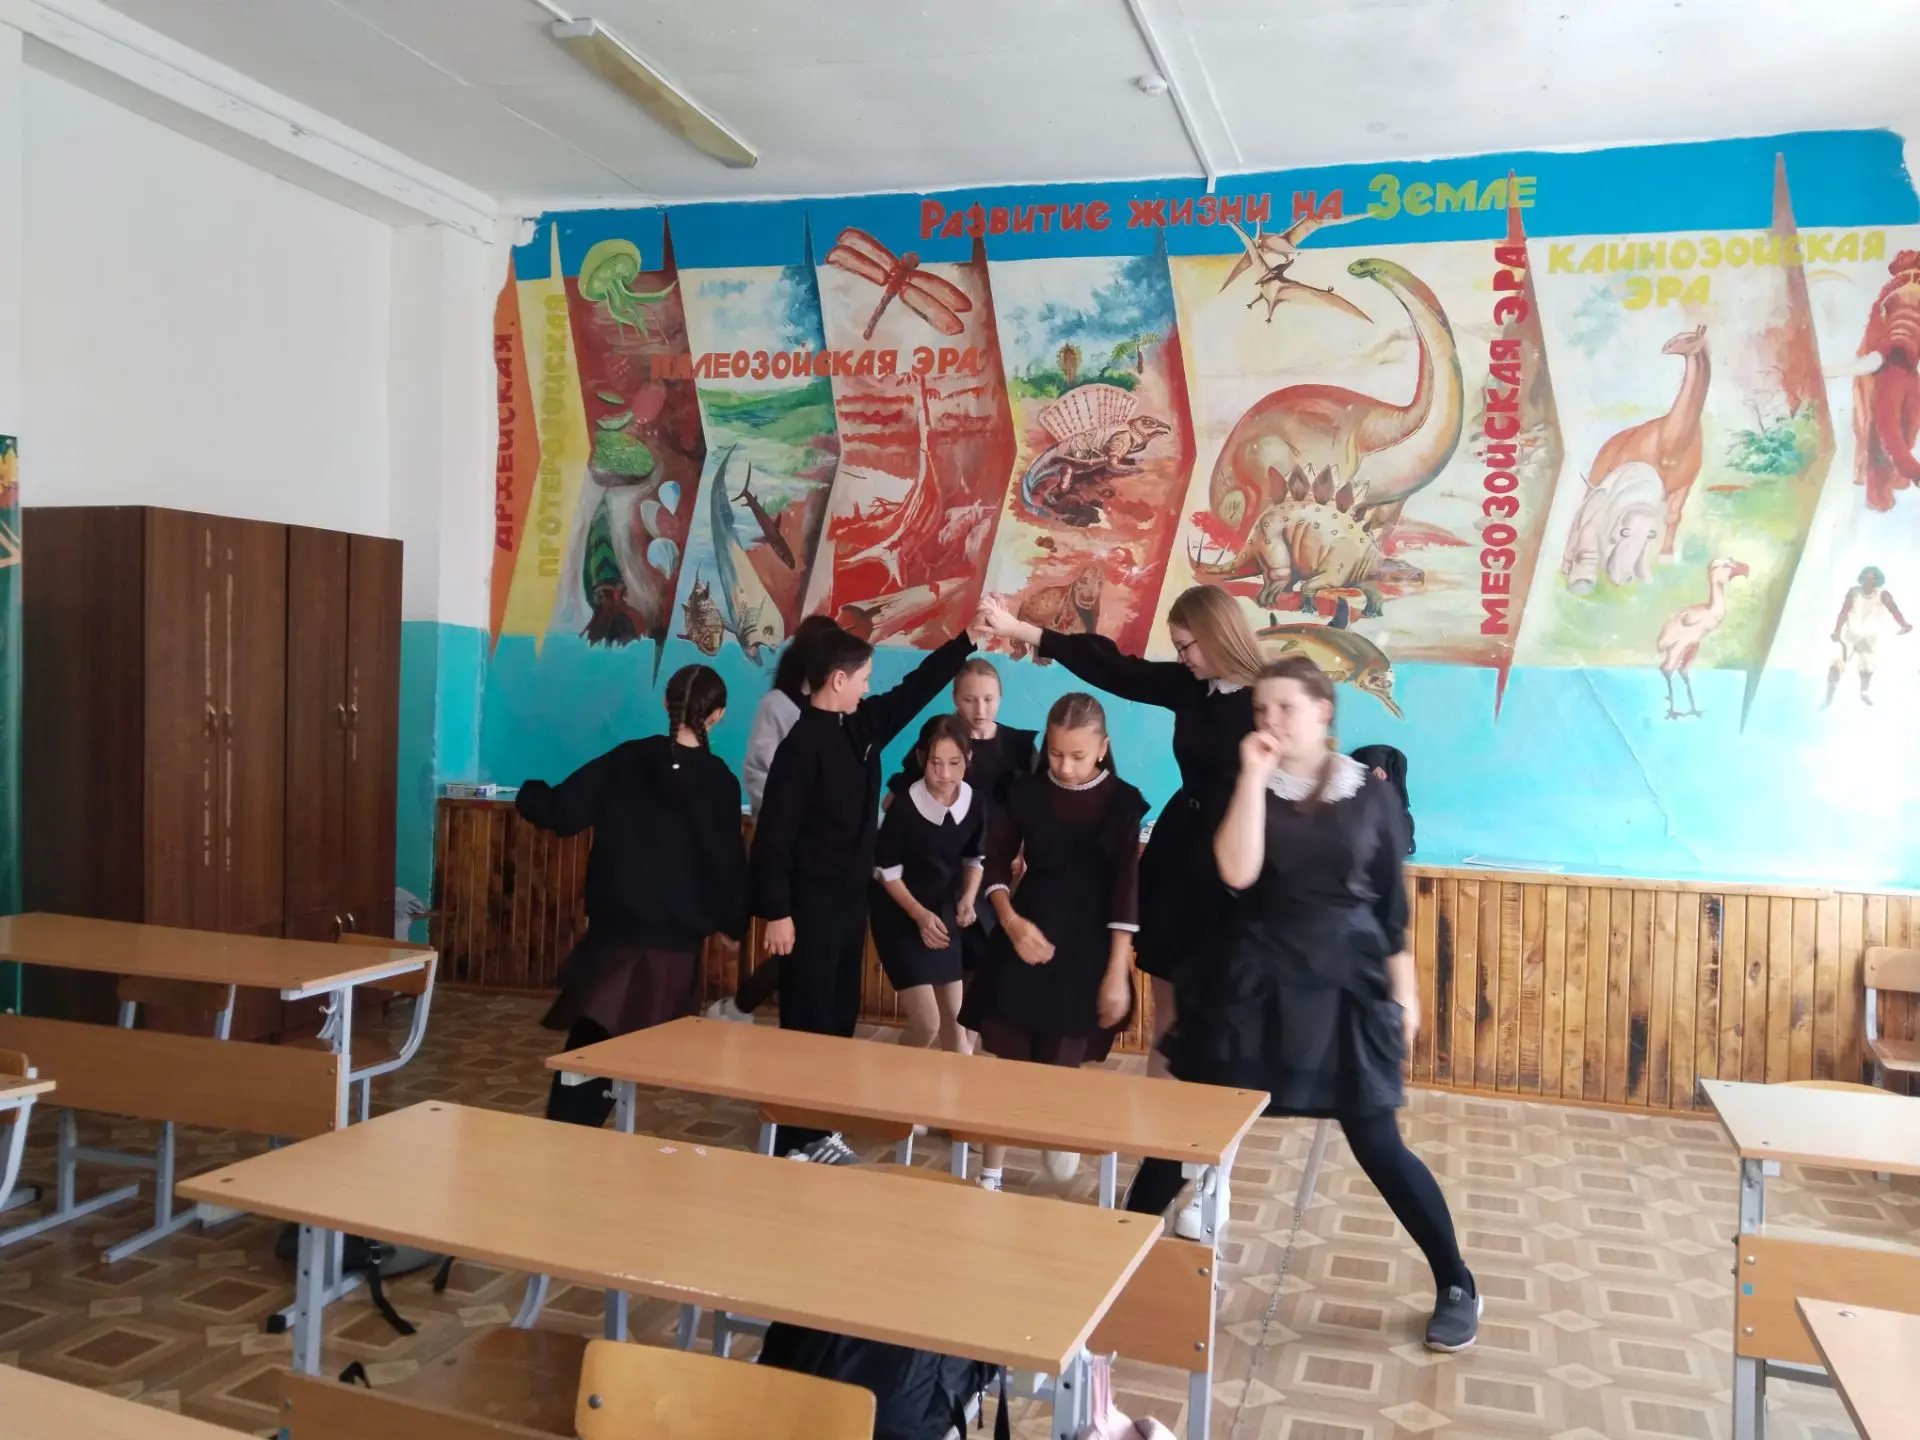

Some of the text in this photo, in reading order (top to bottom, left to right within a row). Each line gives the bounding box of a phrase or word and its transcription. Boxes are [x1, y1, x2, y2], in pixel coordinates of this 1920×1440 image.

[1493, 244, 1529, 327] ЭРА
[1624, 275, 1711, 311] ЭРА
[911, 345, 979, 376] ЭРА
